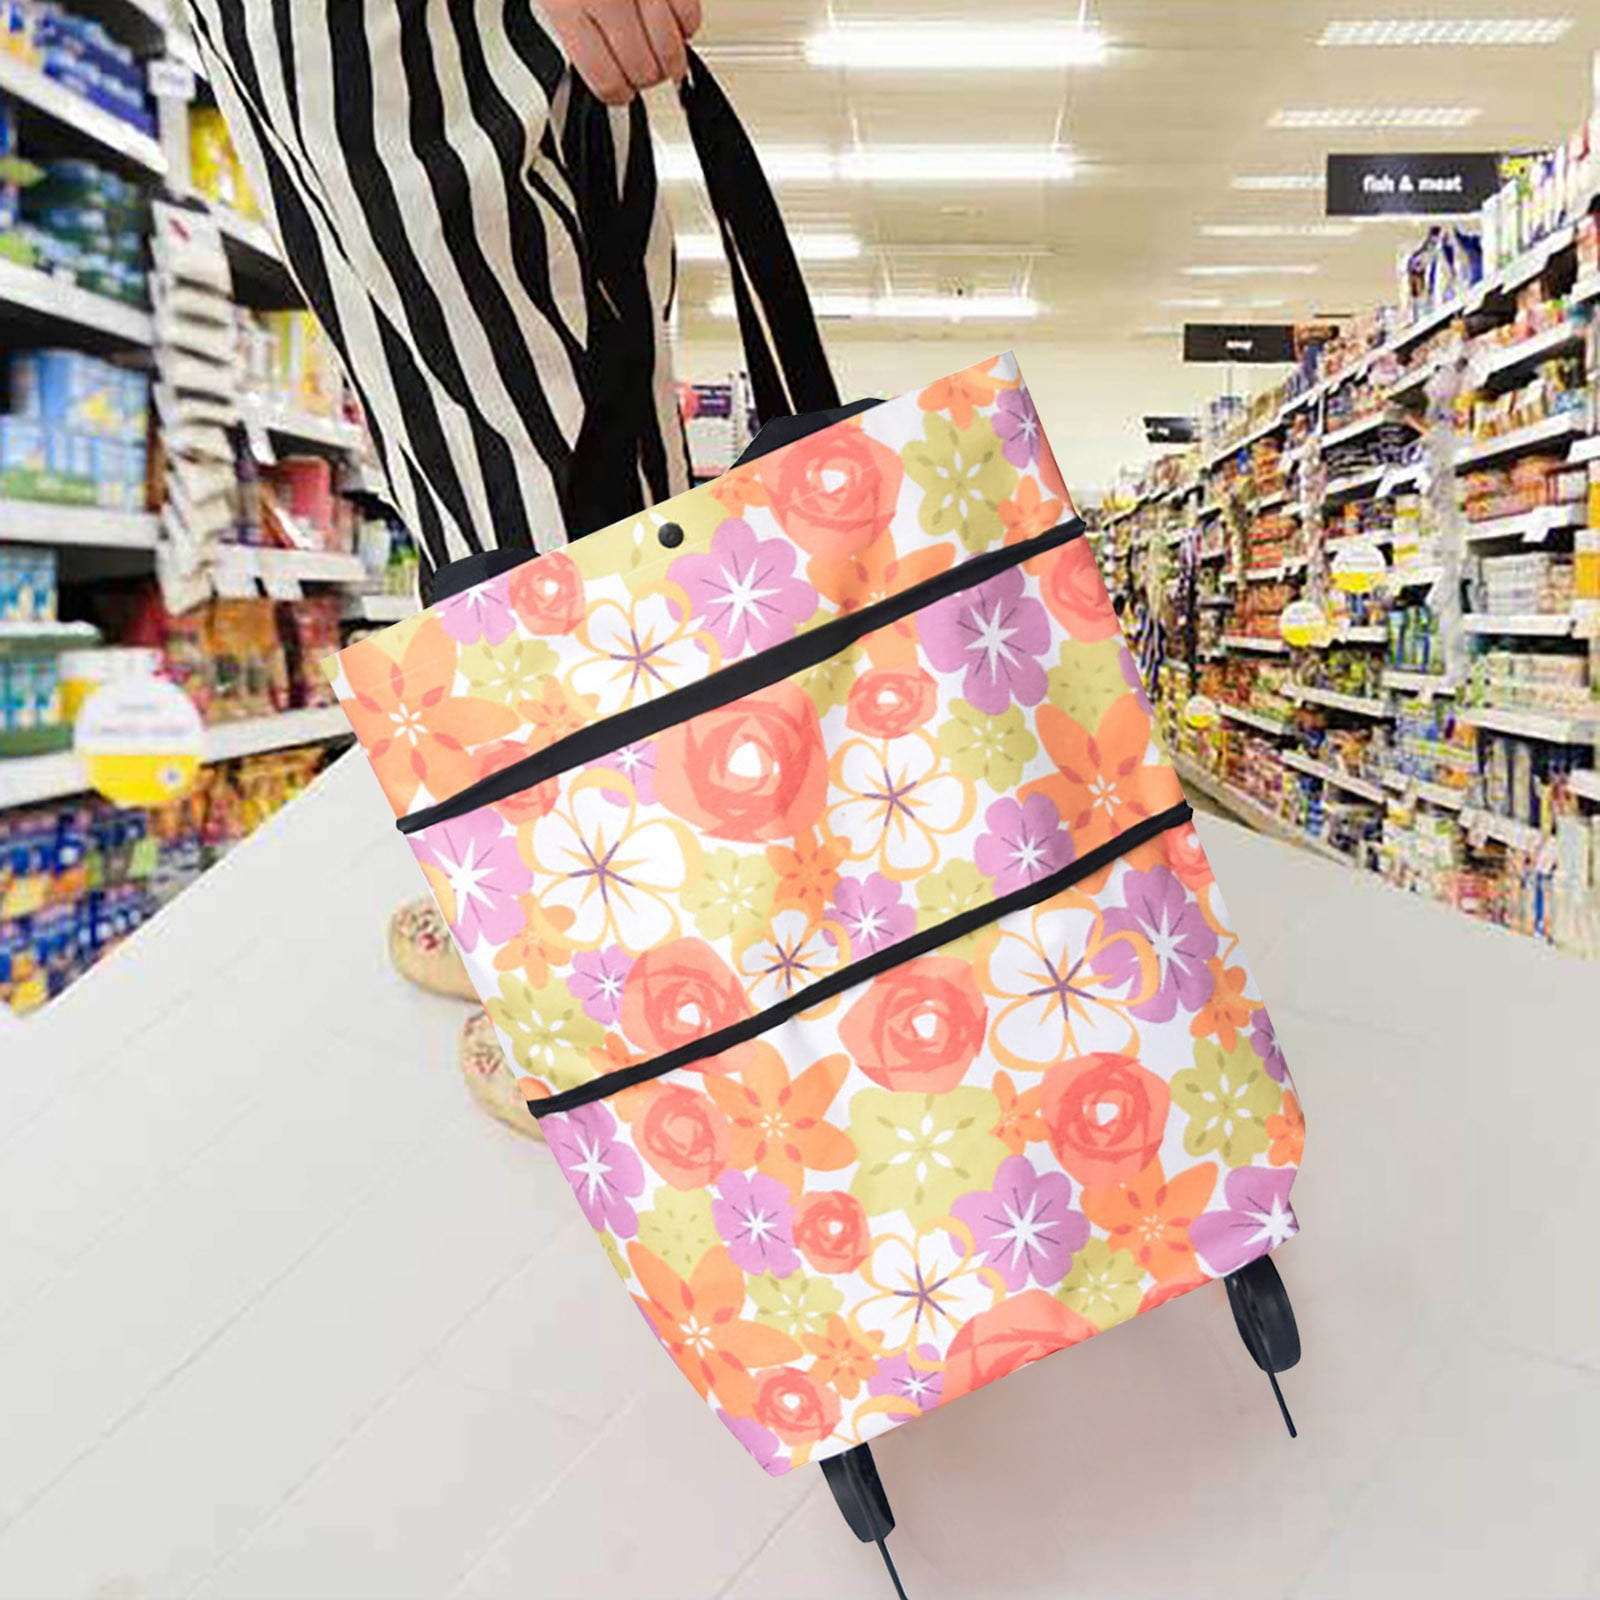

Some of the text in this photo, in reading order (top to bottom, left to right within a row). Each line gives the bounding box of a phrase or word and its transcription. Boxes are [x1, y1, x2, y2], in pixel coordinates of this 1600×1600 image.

[1363, 174, 1463, 193] fish & meat
